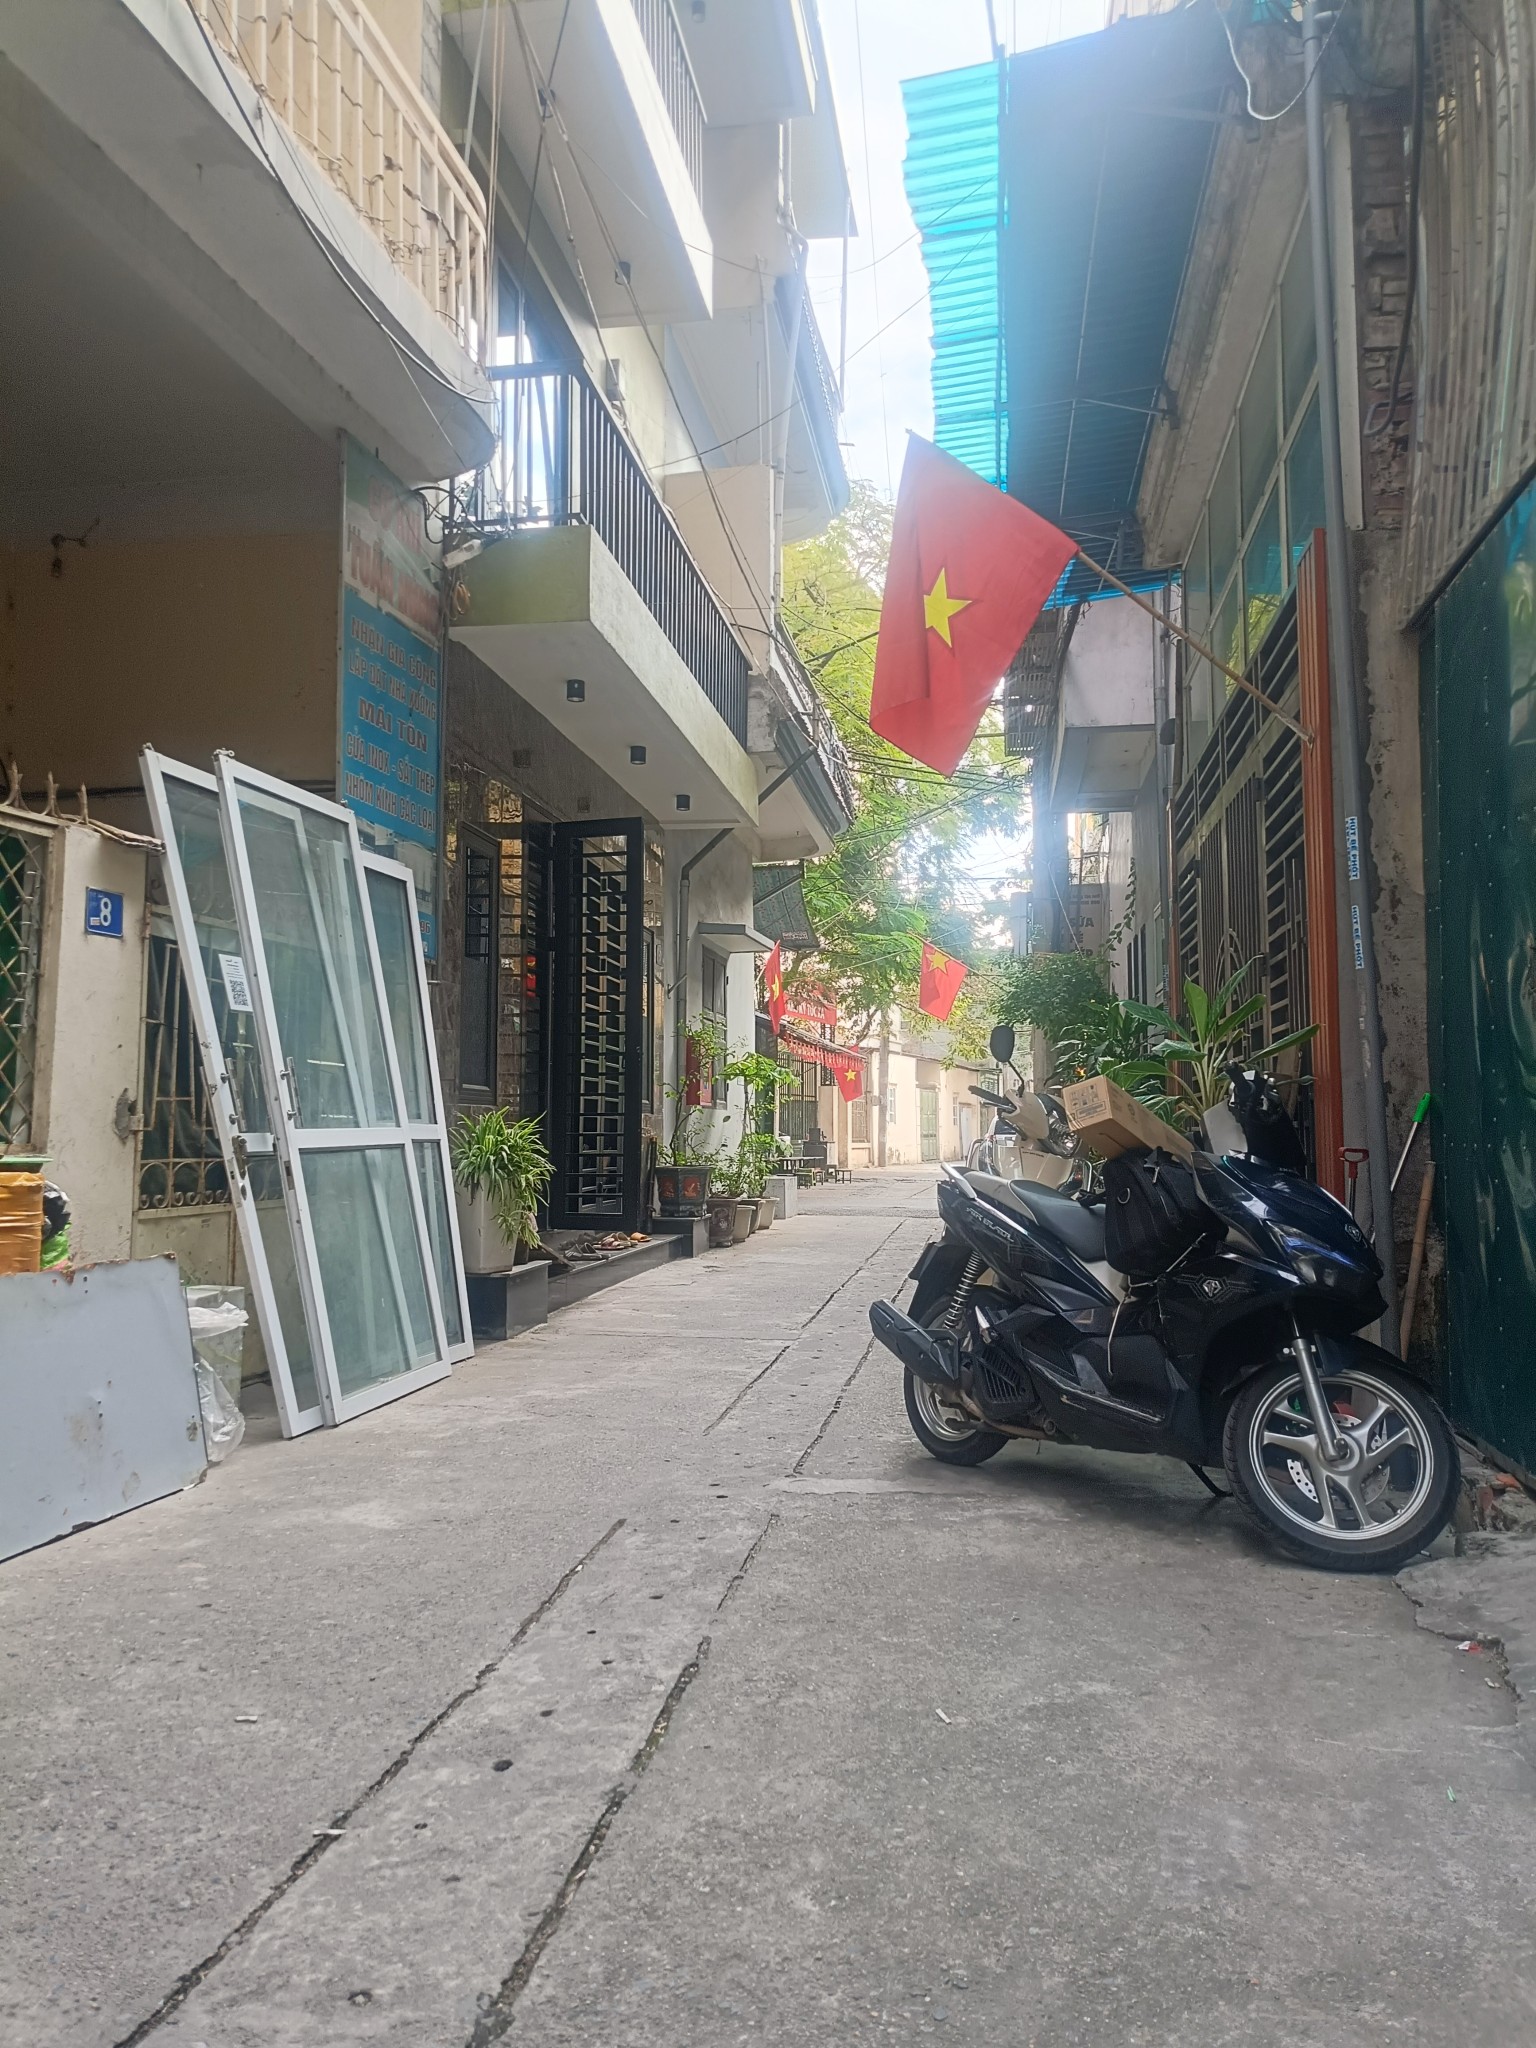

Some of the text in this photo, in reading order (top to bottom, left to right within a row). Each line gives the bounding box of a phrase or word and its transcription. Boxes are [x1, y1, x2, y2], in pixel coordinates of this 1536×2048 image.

[351, 615, 437, 690] NHẬN GIA CÔNG
[358, 696, 428, 754] MÁI TÔN
[368, 742, 391, 776] INOX
[344, 770, 437, 836] NHÔM KÍNH CÁC LOẠI
[100, 897, 112, 927] 8
